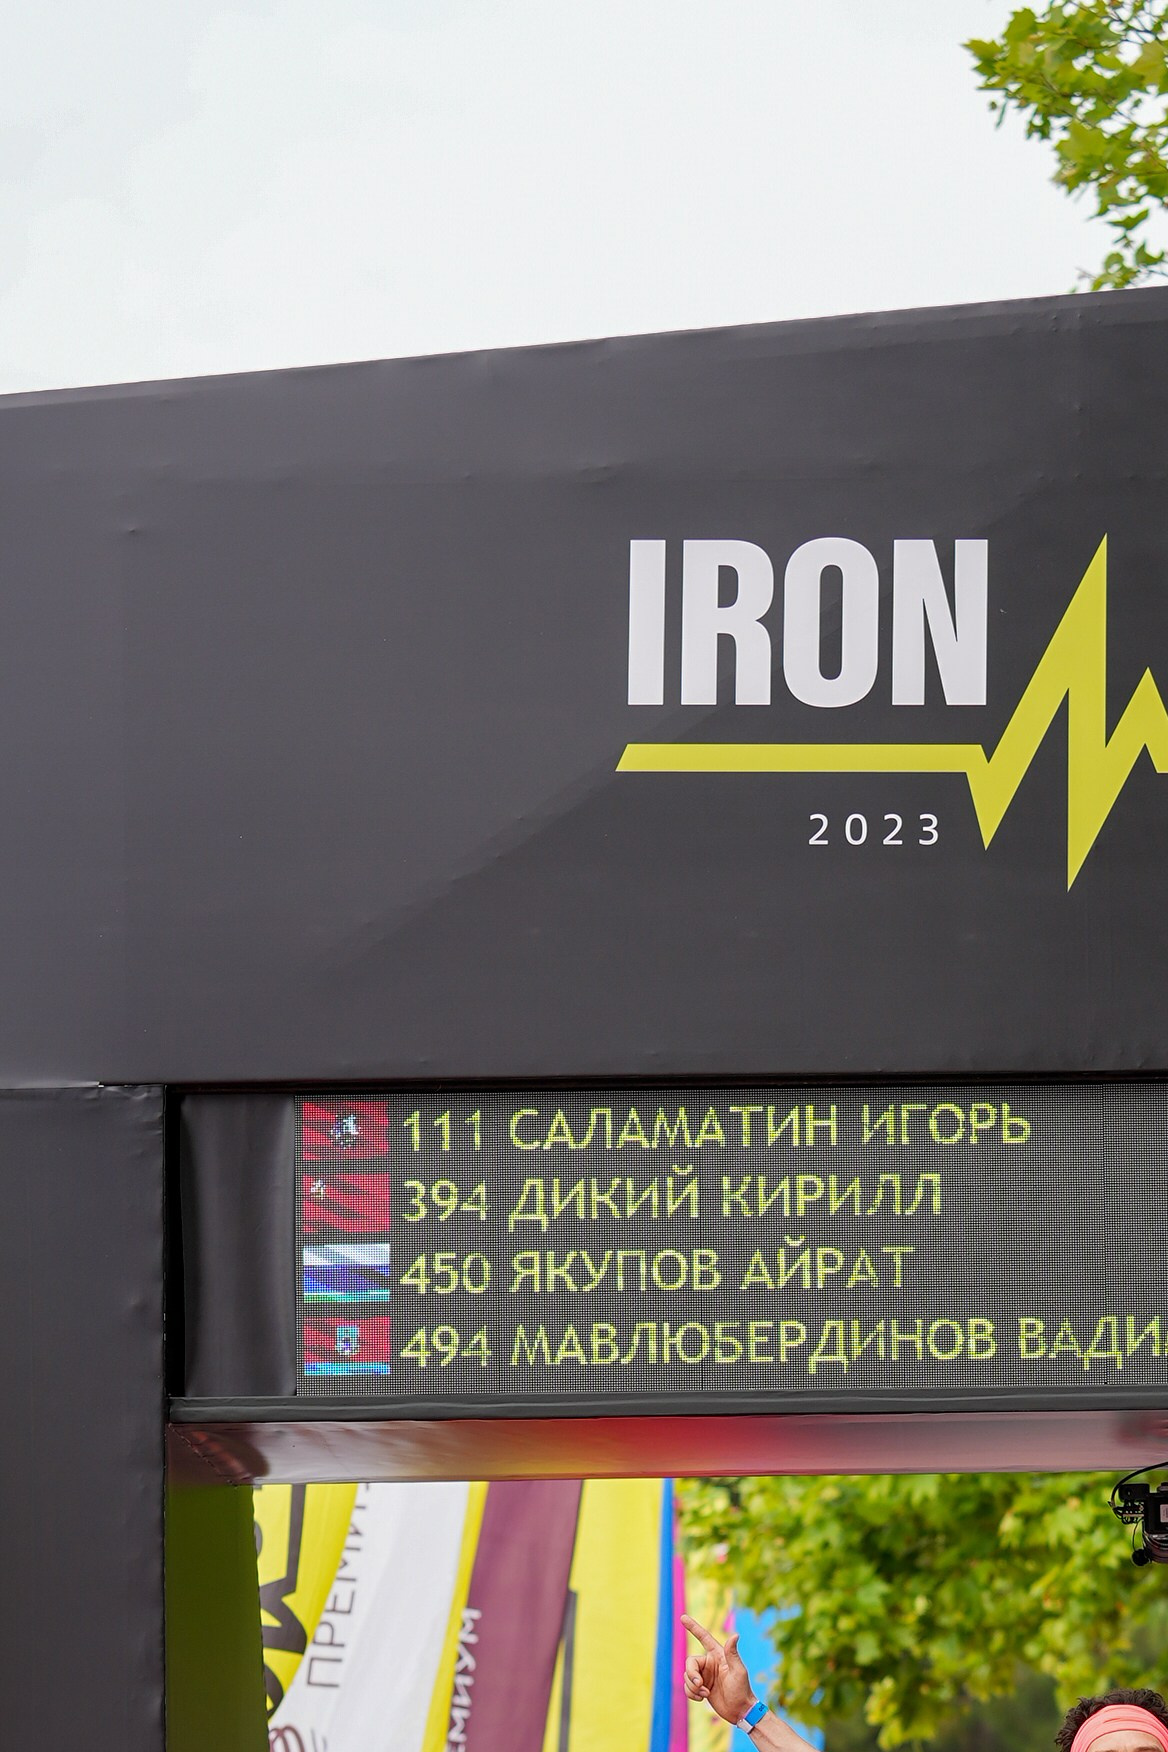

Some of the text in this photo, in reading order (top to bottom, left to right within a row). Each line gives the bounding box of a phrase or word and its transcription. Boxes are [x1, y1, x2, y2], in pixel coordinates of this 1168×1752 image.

[626, 536, 990, 709] IRON
[807, 812, 940, 847] 2023
[403, 1110, 482, 1151] 111
[508, 1103, 839, 1150] САЛАМАТИН
[862, 1101, 1031, 1145] ИГОРЬ
[402, 1177, 489, 1222] 394
[508, 1165, 699, 1231] ДИКИЙ
[721, 1172, 943, 1217] КИРИЛЛ
[399, 1251, 491, 1293] 450
[511, 1248, 722, 1292] ЯКУПОВ
[741, 1235, 915, 1290] АЙРАТ
[400, 1324, 492, 1367] 494
[510, 1319, 998, 1374] МАВЛЮБЕРДИНОВ
